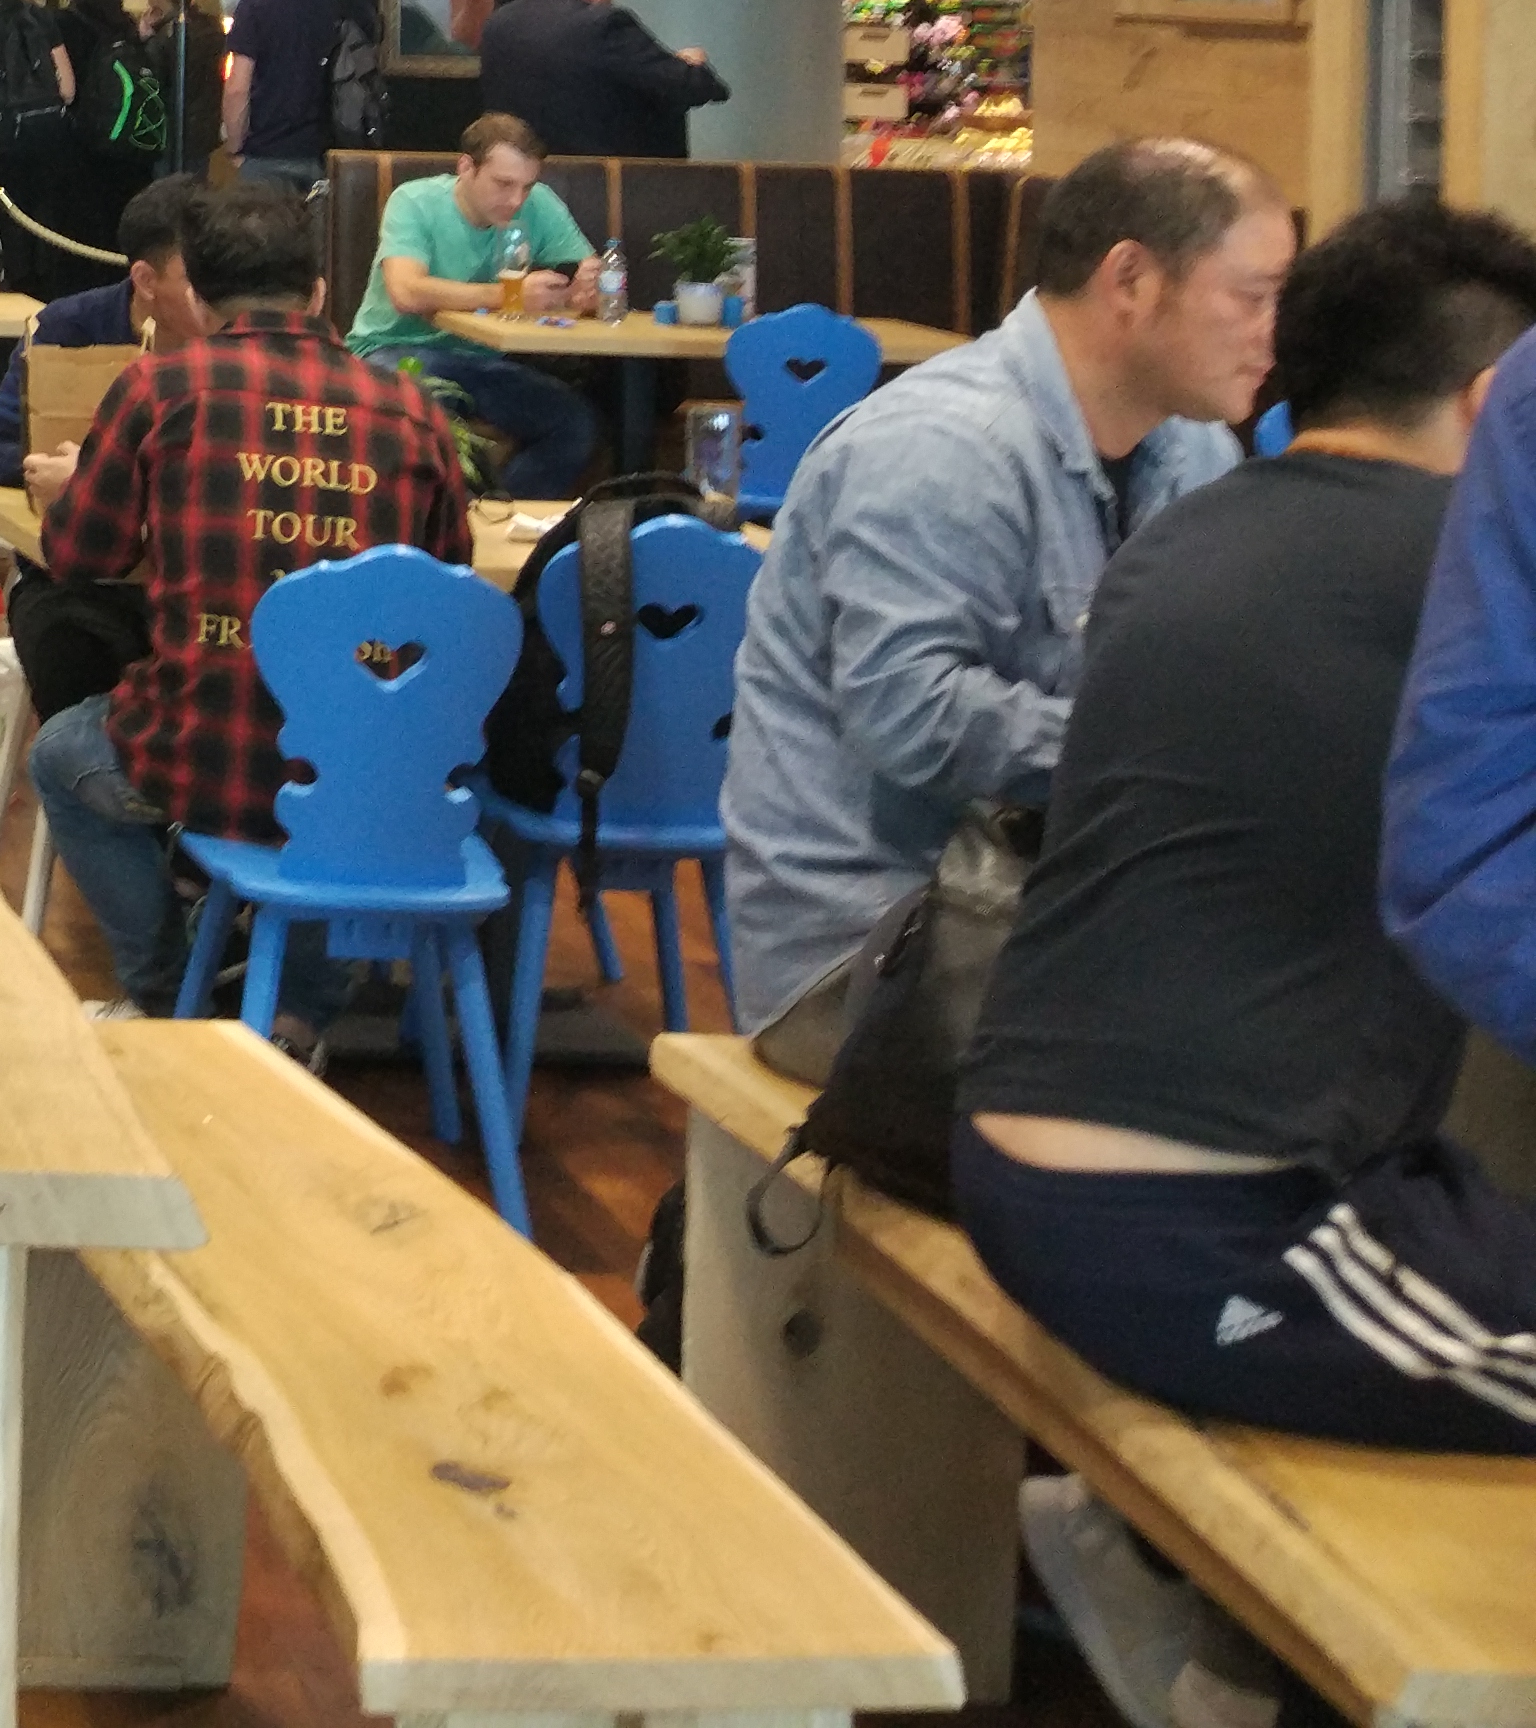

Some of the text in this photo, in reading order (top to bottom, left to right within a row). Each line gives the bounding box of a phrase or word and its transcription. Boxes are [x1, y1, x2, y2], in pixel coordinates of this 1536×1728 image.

[264, 401, 348, 436] THE
[235, 452, 378, 496] WORLD
[246, 508, 361, 551] TOUR
